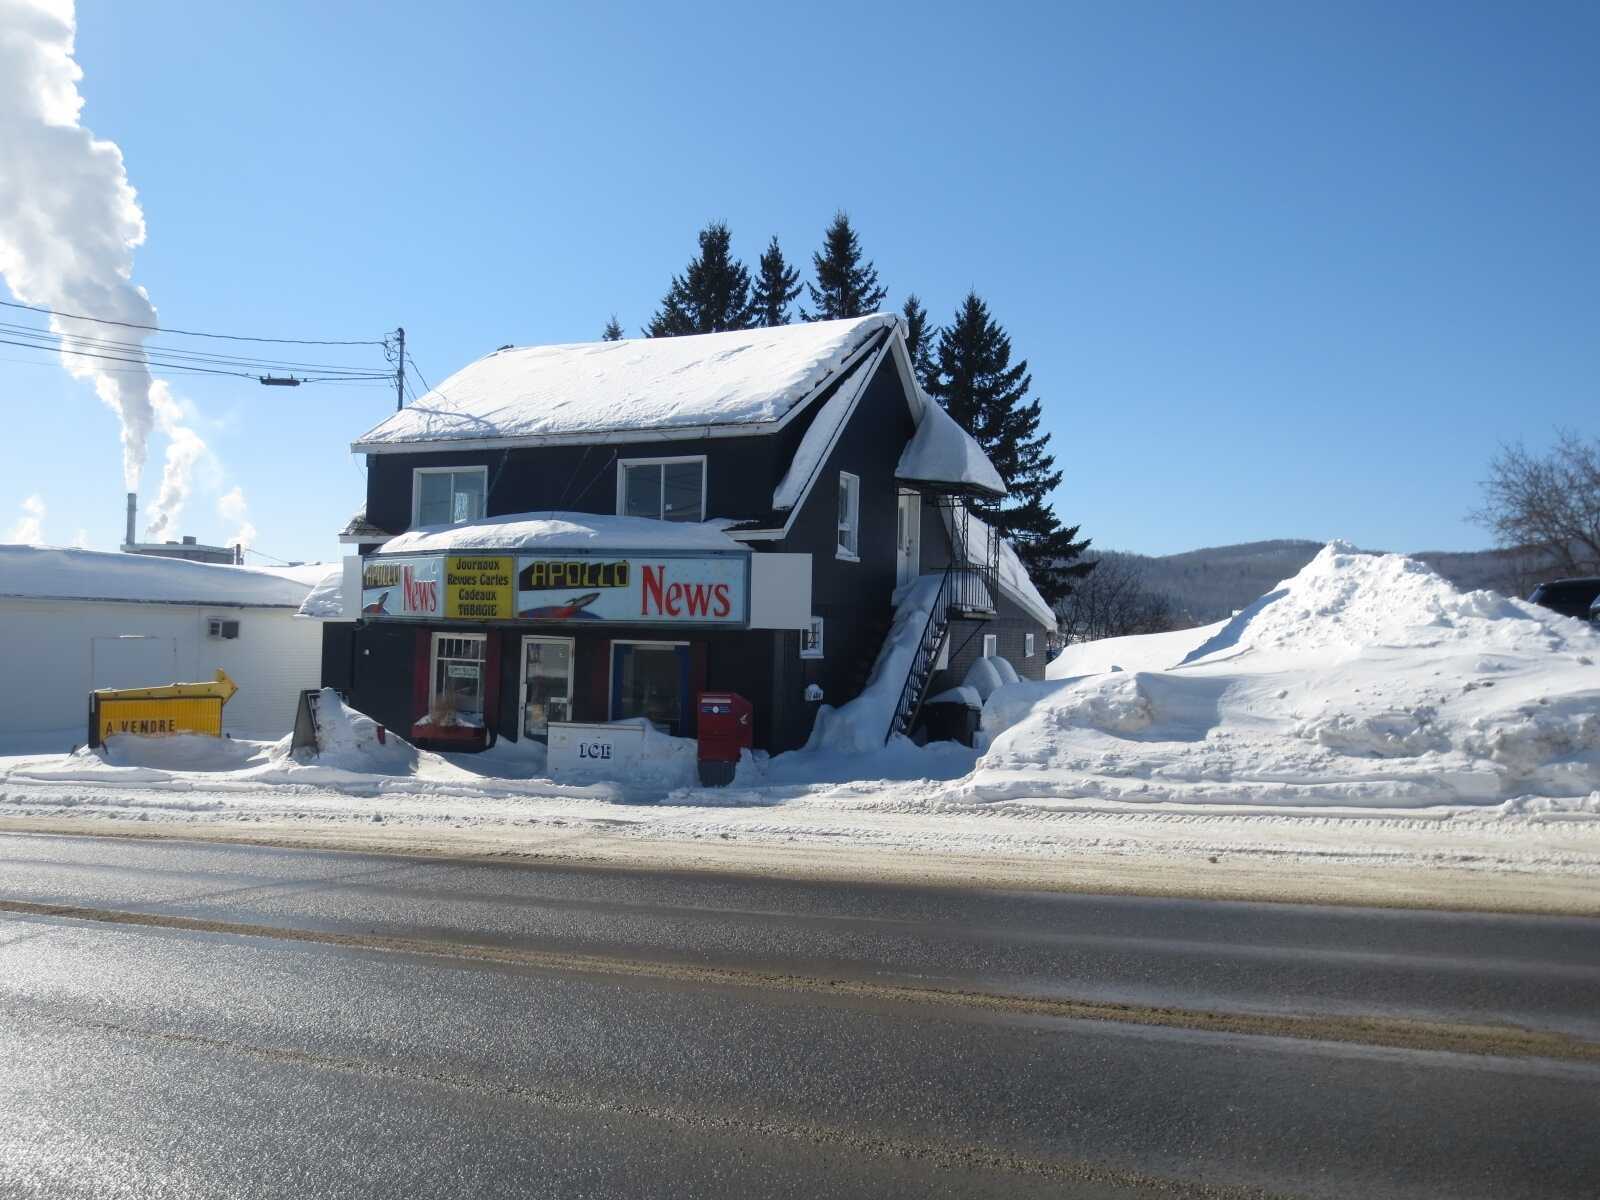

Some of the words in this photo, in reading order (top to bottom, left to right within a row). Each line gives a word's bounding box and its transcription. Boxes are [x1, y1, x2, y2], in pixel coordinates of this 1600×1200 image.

[456, 558, 500, 571] Journaux
[448, 574, 478, 585] Revues
[479, 574, 509, 586] Cartes
[403, 565, 437, 612] News
[458, 588, 497, 601] Cadeaux
[531, 560, 631, 587] APOLLO
[641, 565, 731, 617] News
[458, 603, 497, 617] TABAGIE
[106, 721, 113, 736] A
[121, 719, 176, 733] VENDRE
[579, 742, 611, 759] ICE
